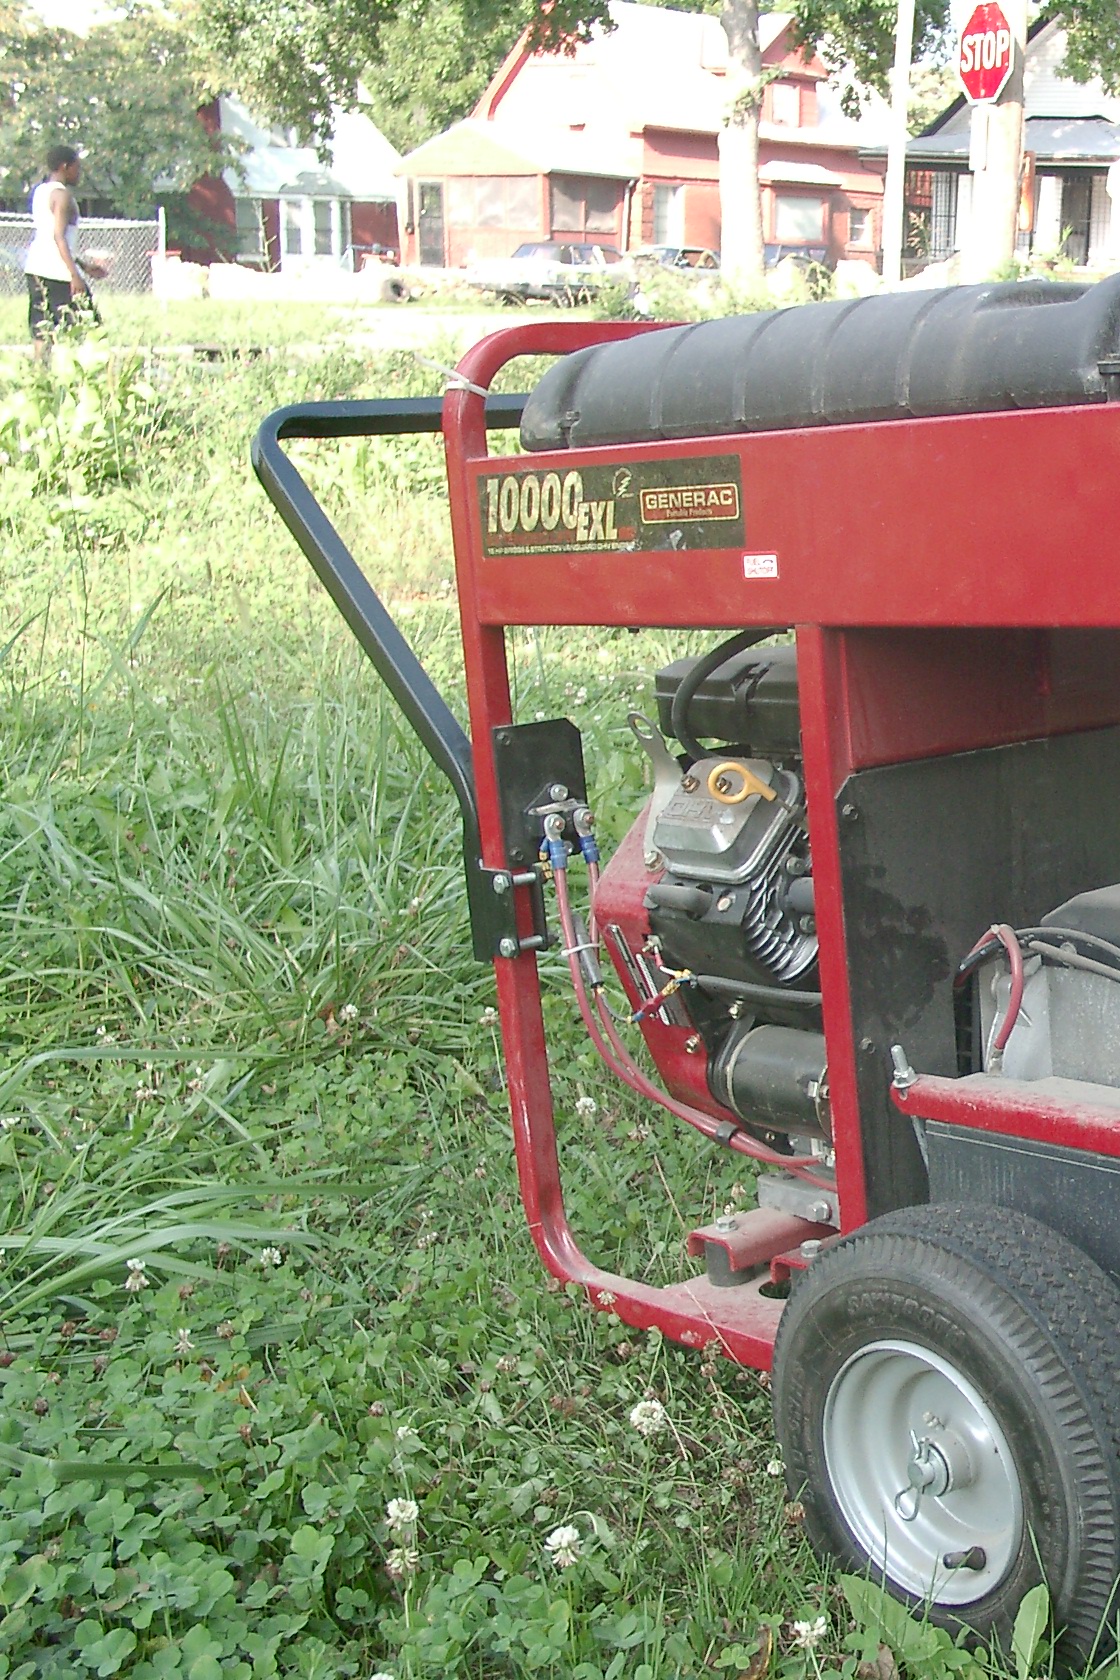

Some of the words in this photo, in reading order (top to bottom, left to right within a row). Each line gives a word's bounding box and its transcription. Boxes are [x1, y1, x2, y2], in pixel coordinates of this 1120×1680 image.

[961, 30, 1010, 73] STOP
[487, 471, 584, 533] 10000
[576, 500, 618, 541] EXL
[646, 490, 733, 509] GENERAC
